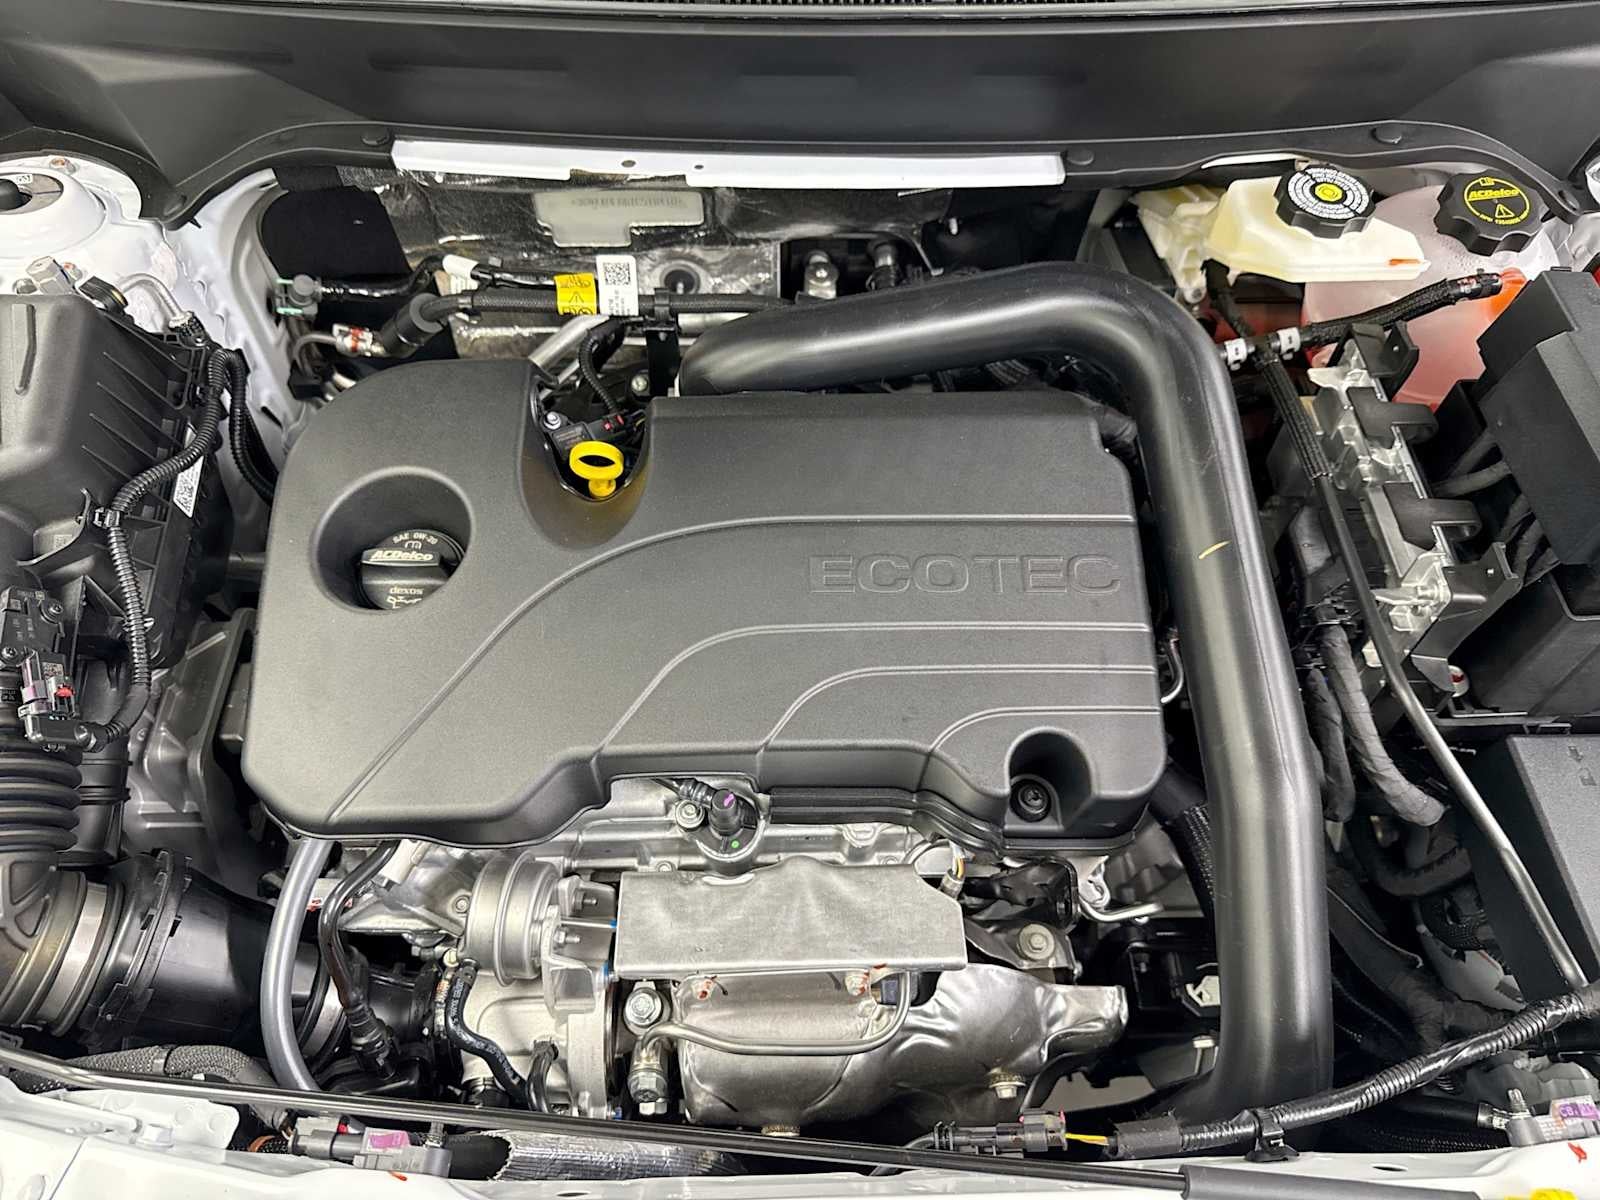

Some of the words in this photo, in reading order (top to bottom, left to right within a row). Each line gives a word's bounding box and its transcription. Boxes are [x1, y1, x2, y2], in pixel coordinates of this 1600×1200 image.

[1468, 188, 1521, 201] ACDelco
[392, 532, 410, 544] SAE
[413, 532, 438, 545] 0W-20
[369, 549, 434, 561] ACDelco
[808, 554, 1121, 594] ECOTEC
[389, 586, 424, 595] dexos
